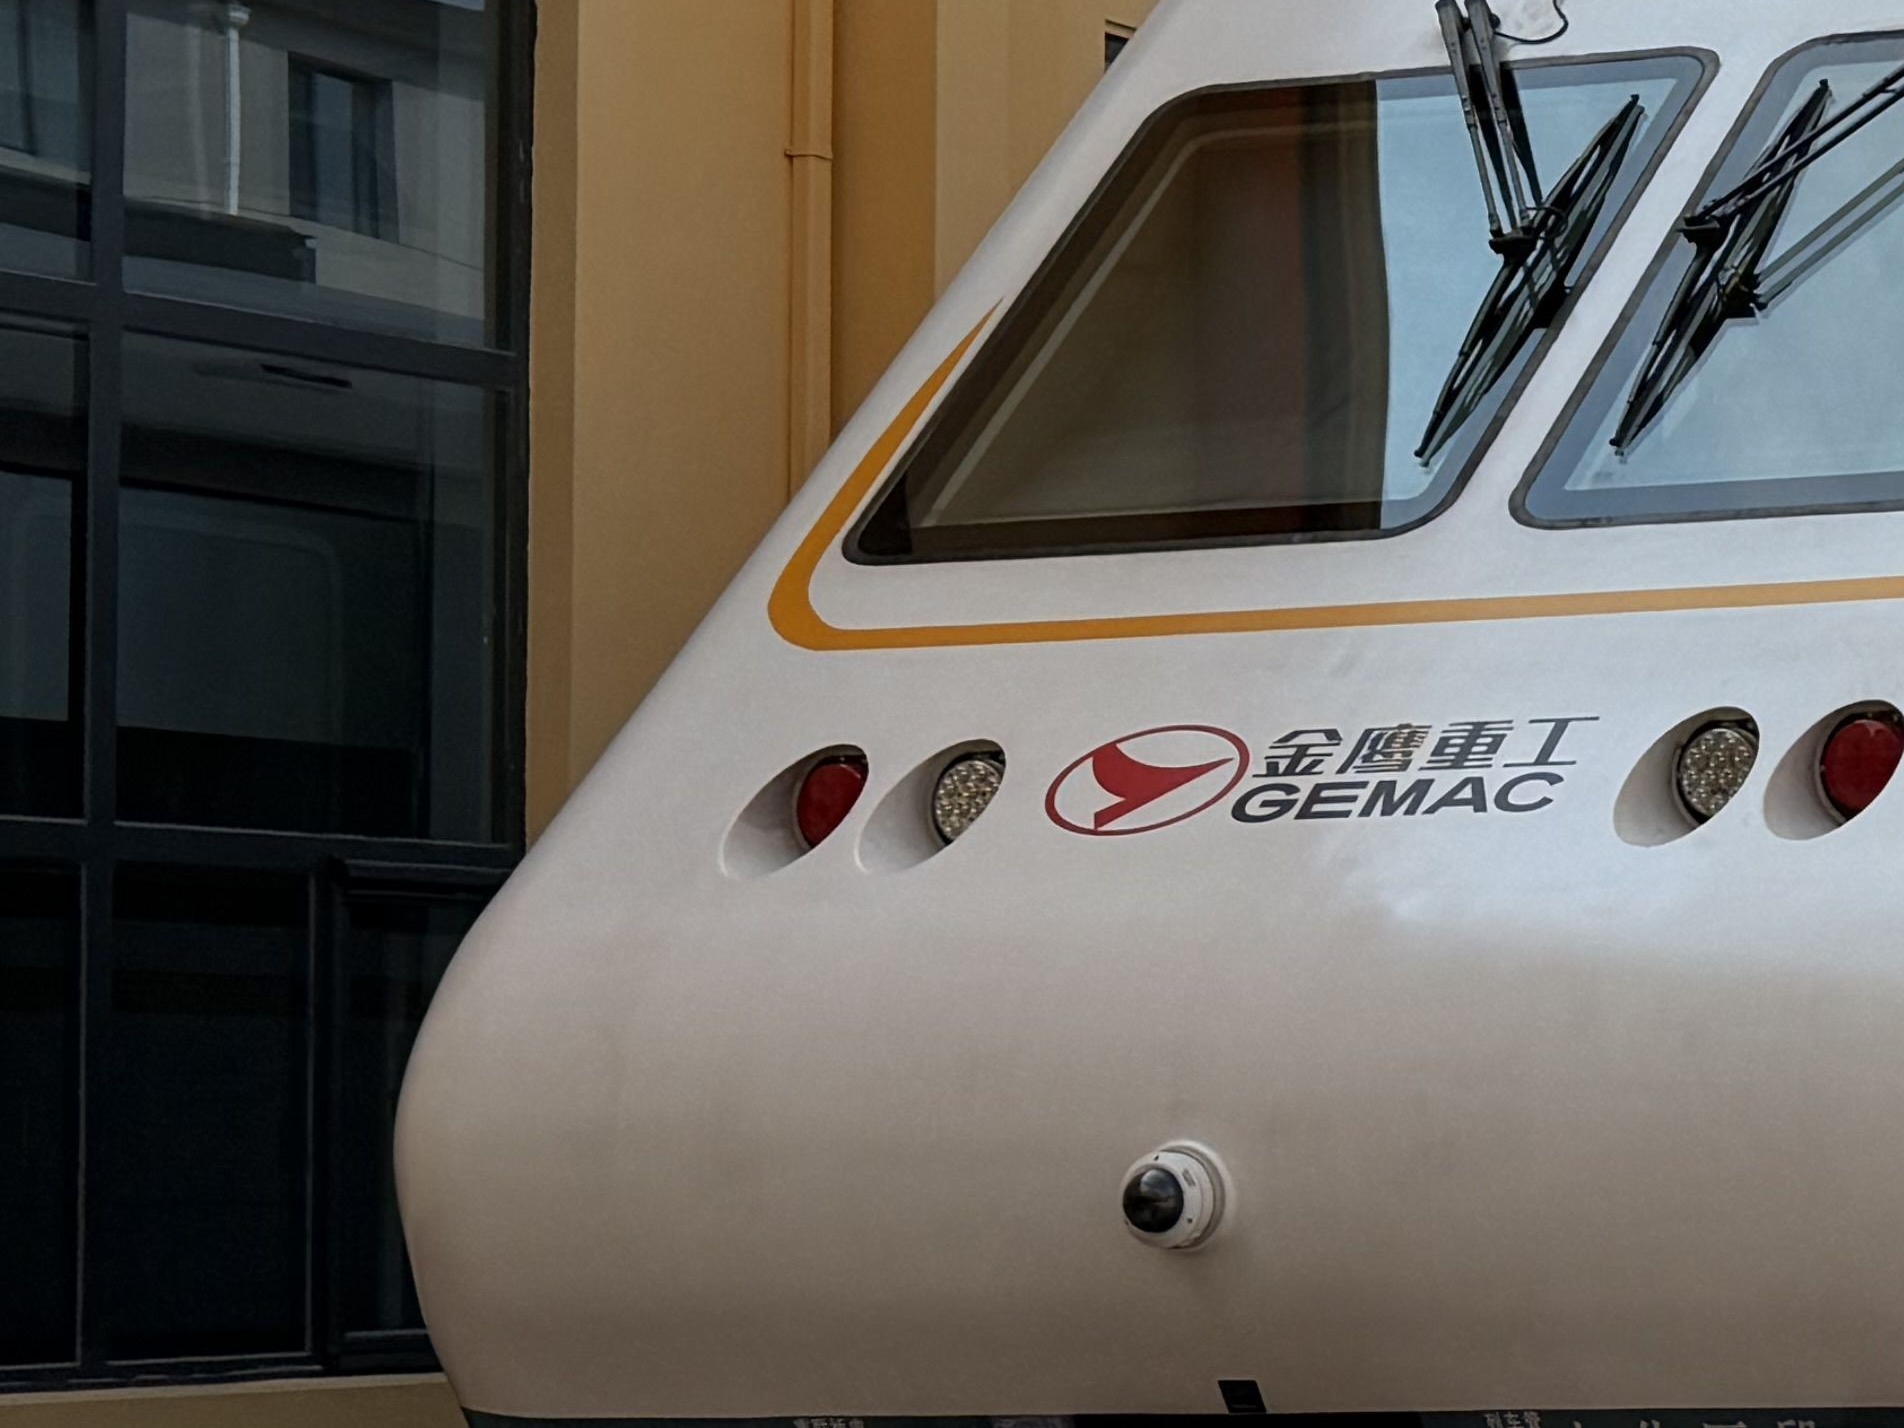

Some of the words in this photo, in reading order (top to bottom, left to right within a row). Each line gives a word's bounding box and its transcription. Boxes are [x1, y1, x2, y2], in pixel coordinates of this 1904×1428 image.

[1251, 715, 1600, 778] 金鹰重工
[1231, 771, 1565, 824] GEMAC
